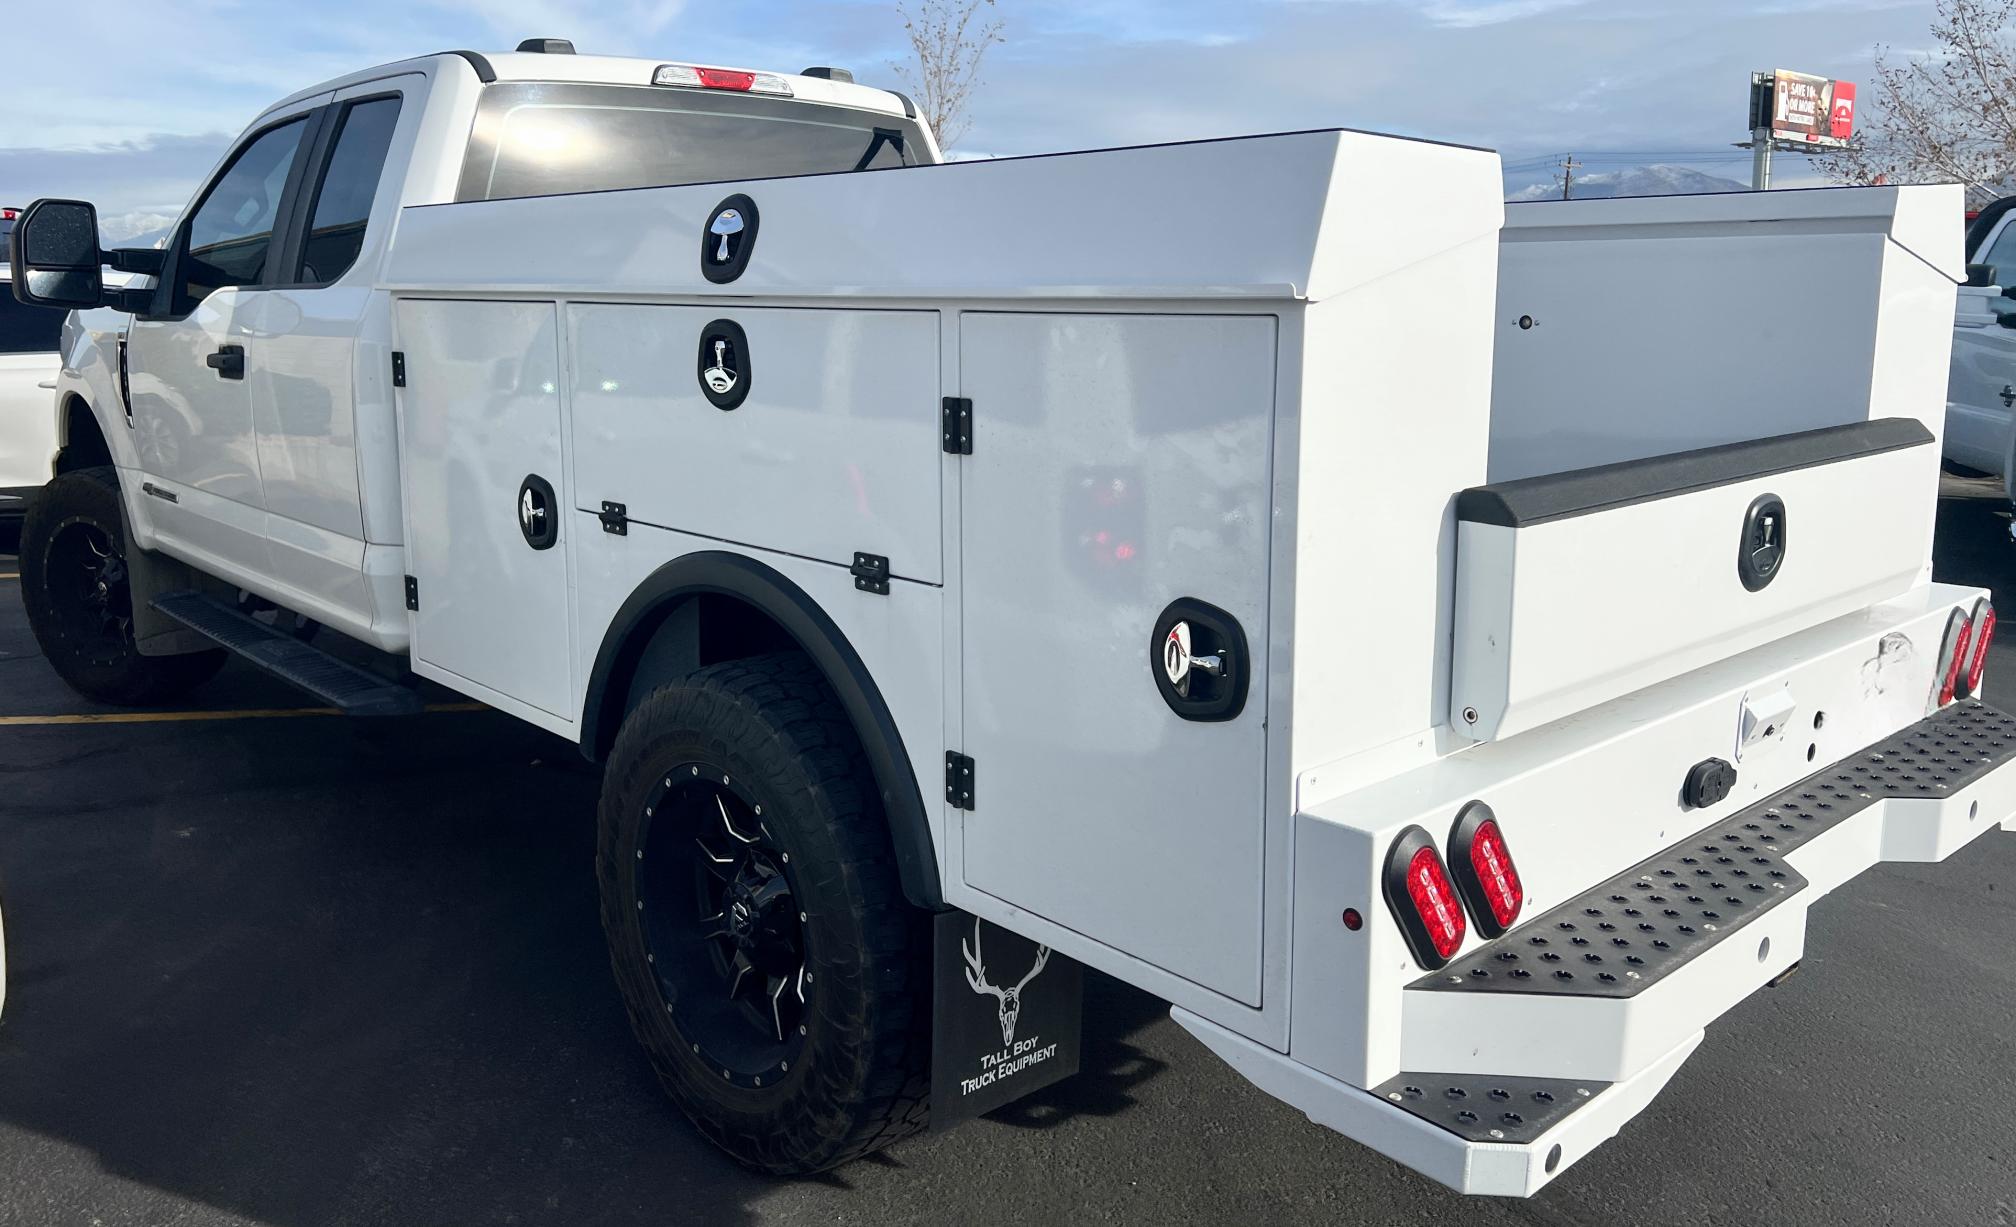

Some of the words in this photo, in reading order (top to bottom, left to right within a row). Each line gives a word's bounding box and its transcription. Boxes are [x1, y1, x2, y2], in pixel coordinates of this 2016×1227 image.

[1791, 83, 1806, 97] SAVE
[1790, 98, 1798, 111] OR
[1798, 99, 1815, 114] MORE
[981, 1050, 1011, 1069] TALL
[1013, 1036, 1039, 1054] BOY
[961, 1069, 997, 1096] TRUCK
[998, 1044, 1057, 1080] EQUIPMENT
